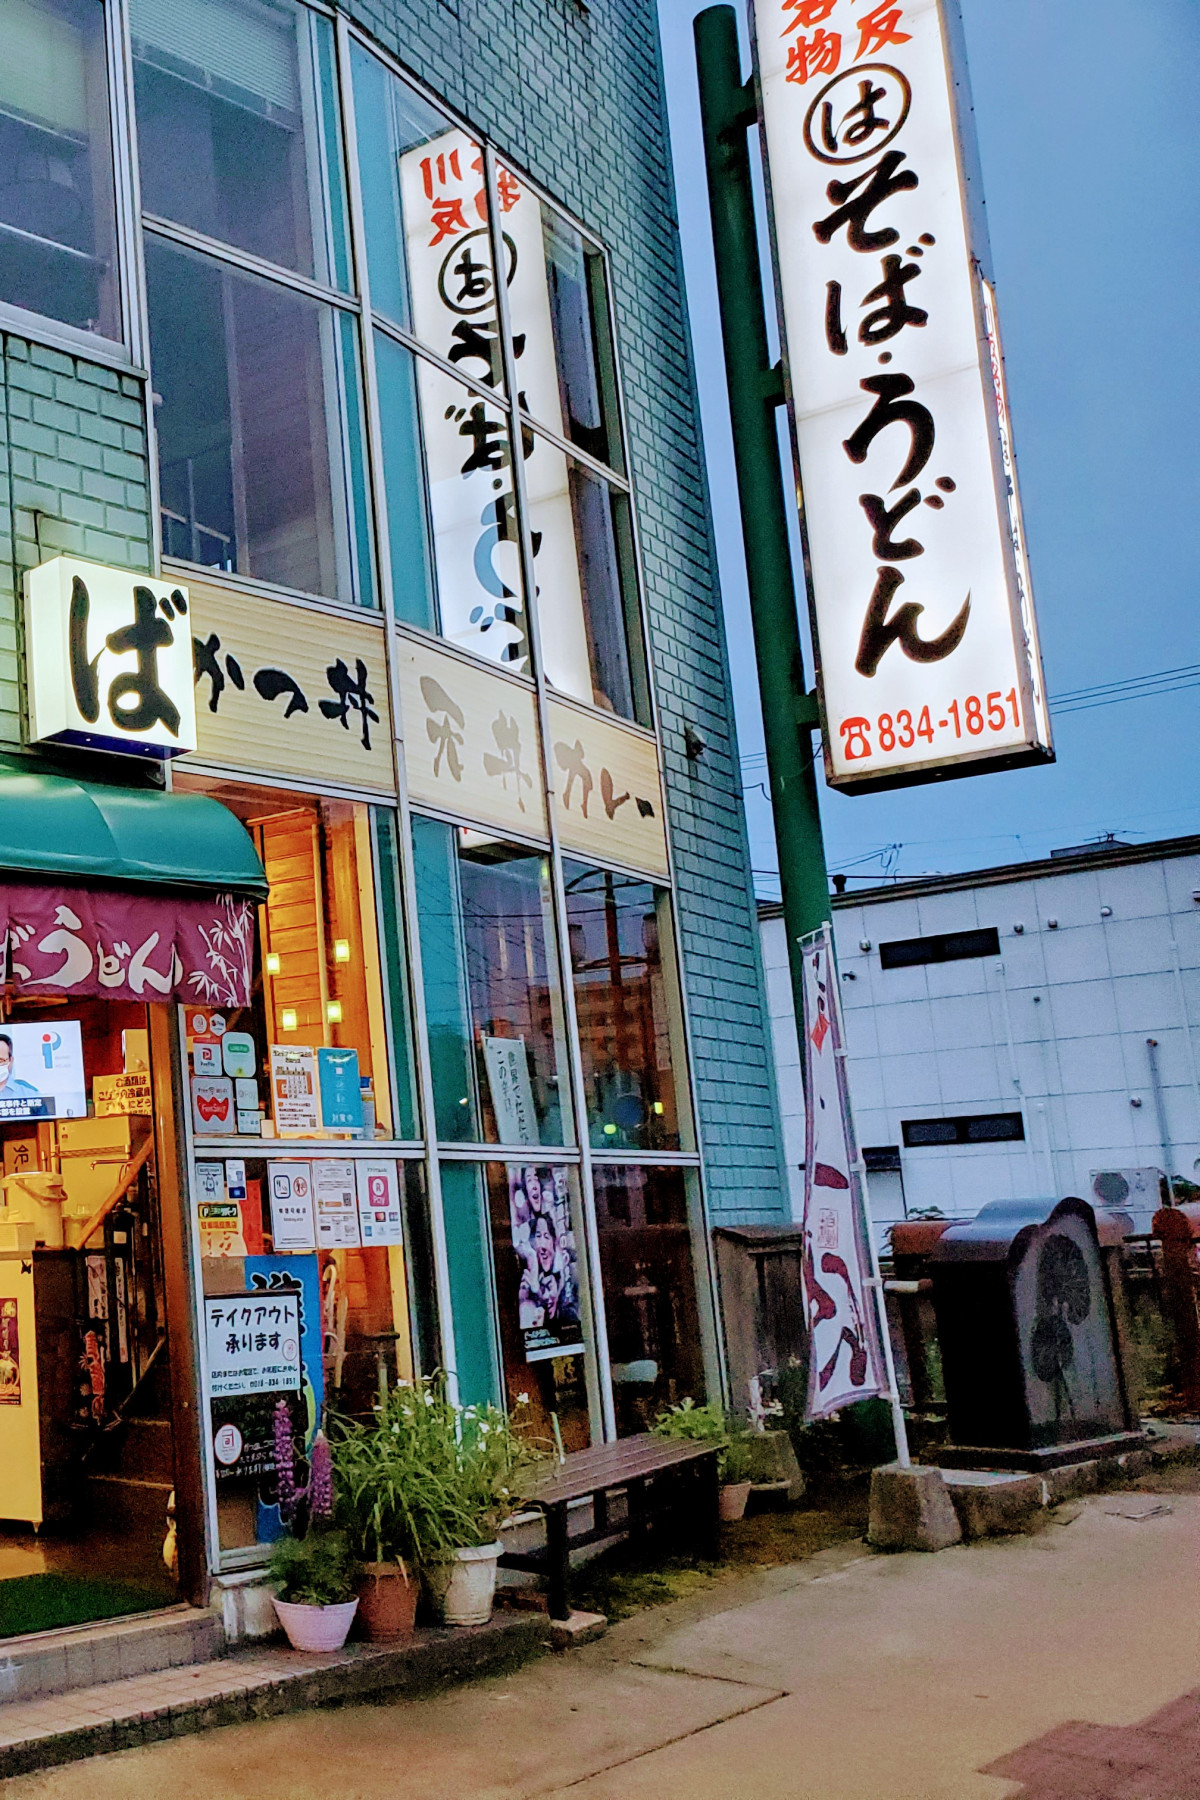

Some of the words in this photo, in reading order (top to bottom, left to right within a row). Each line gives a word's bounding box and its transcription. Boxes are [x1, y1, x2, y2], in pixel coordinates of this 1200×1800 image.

[850, 0, 913, 63] 反
[811, 151, 972, 677] そば・うどん
[194, 632, 380, 751] かつ丼
[553, 738, 655, 820] カレー
[878, 688, 1021, 752] 834-1851
[211, 1304, 295, 1328] テイクアウト
[225, 1331, 282, 1354] 承ります
